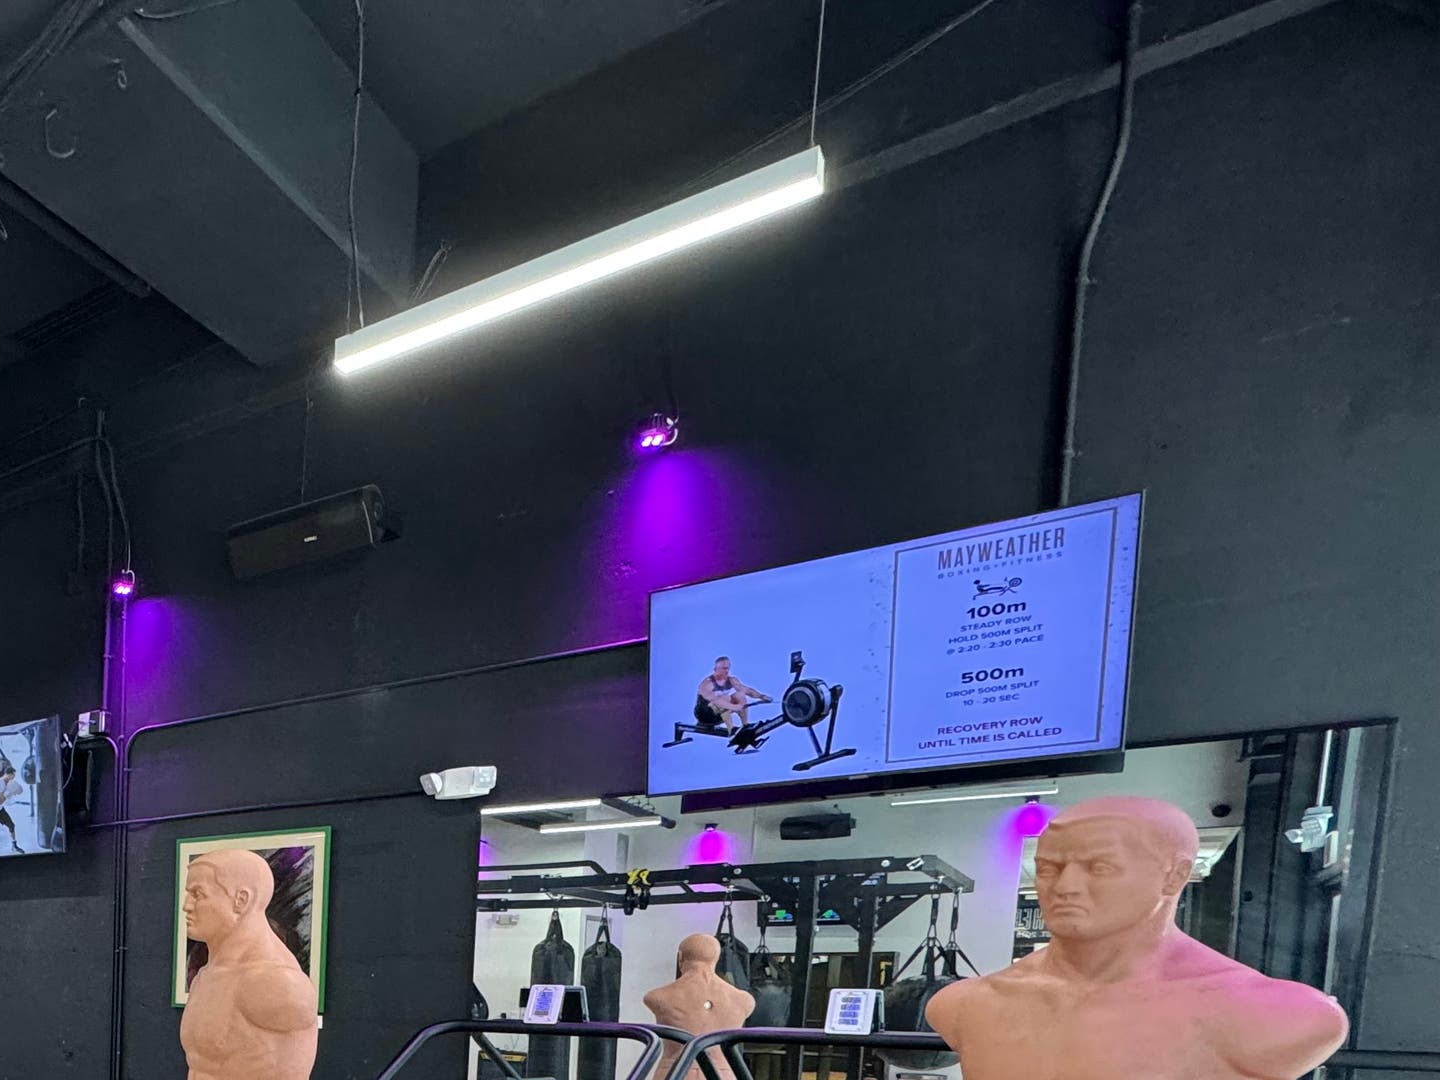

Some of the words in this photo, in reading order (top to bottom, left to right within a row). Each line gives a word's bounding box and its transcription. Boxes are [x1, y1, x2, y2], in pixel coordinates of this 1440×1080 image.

[937, 527, 1065, 571] MAYWEATHER
[966, 602, 1027, 619] 100m
[960, 620, 1002, 632] STEADY
[1005, 615, 1032, 625] ROW
[948, 634, 978, 644] HOLD
[981, 629, 1011, 640] 500M
[1014, 624, 1044, 635] SPLIT
[1015, 634, 1044, 645] PACE
[961, 667, 1024, 684] 500m
[945, 688, 975, 699] DROP
[978, 684, 1007, 694] 500M
[1010, 679, 1040, 690] SPLIT
[999, 692, 1020, 701] SEC
[937, 719, 1007, 735] RECOVERY
[1010, 716, 1043, 727] ROW
[918, 739, 956, 750] UNTIL
[960, 734, 990, 745] TIME
[993, 733, 1005, 742] IS
[1007, 727, 1062, 741] CALLED
